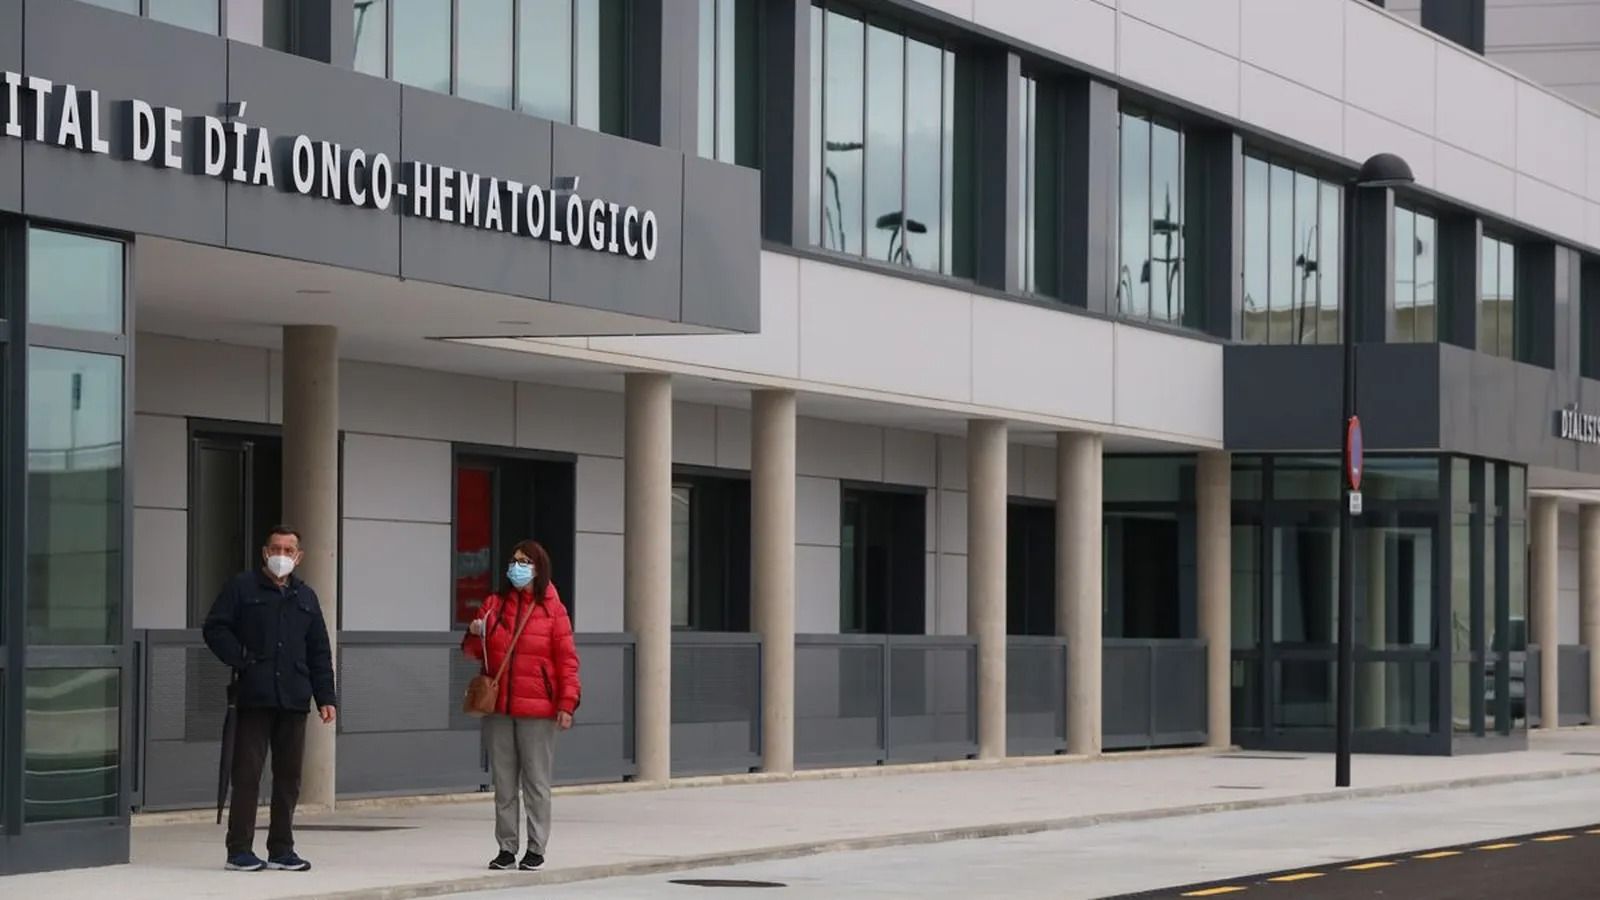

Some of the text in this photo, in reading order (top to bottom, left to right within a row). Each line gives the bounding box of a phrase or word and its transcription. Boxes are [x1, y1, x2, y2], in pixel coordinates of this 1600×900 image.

[5, 71, 658, 261] ITAL DE DÍA ONCO-HEMATOLÓGICO
